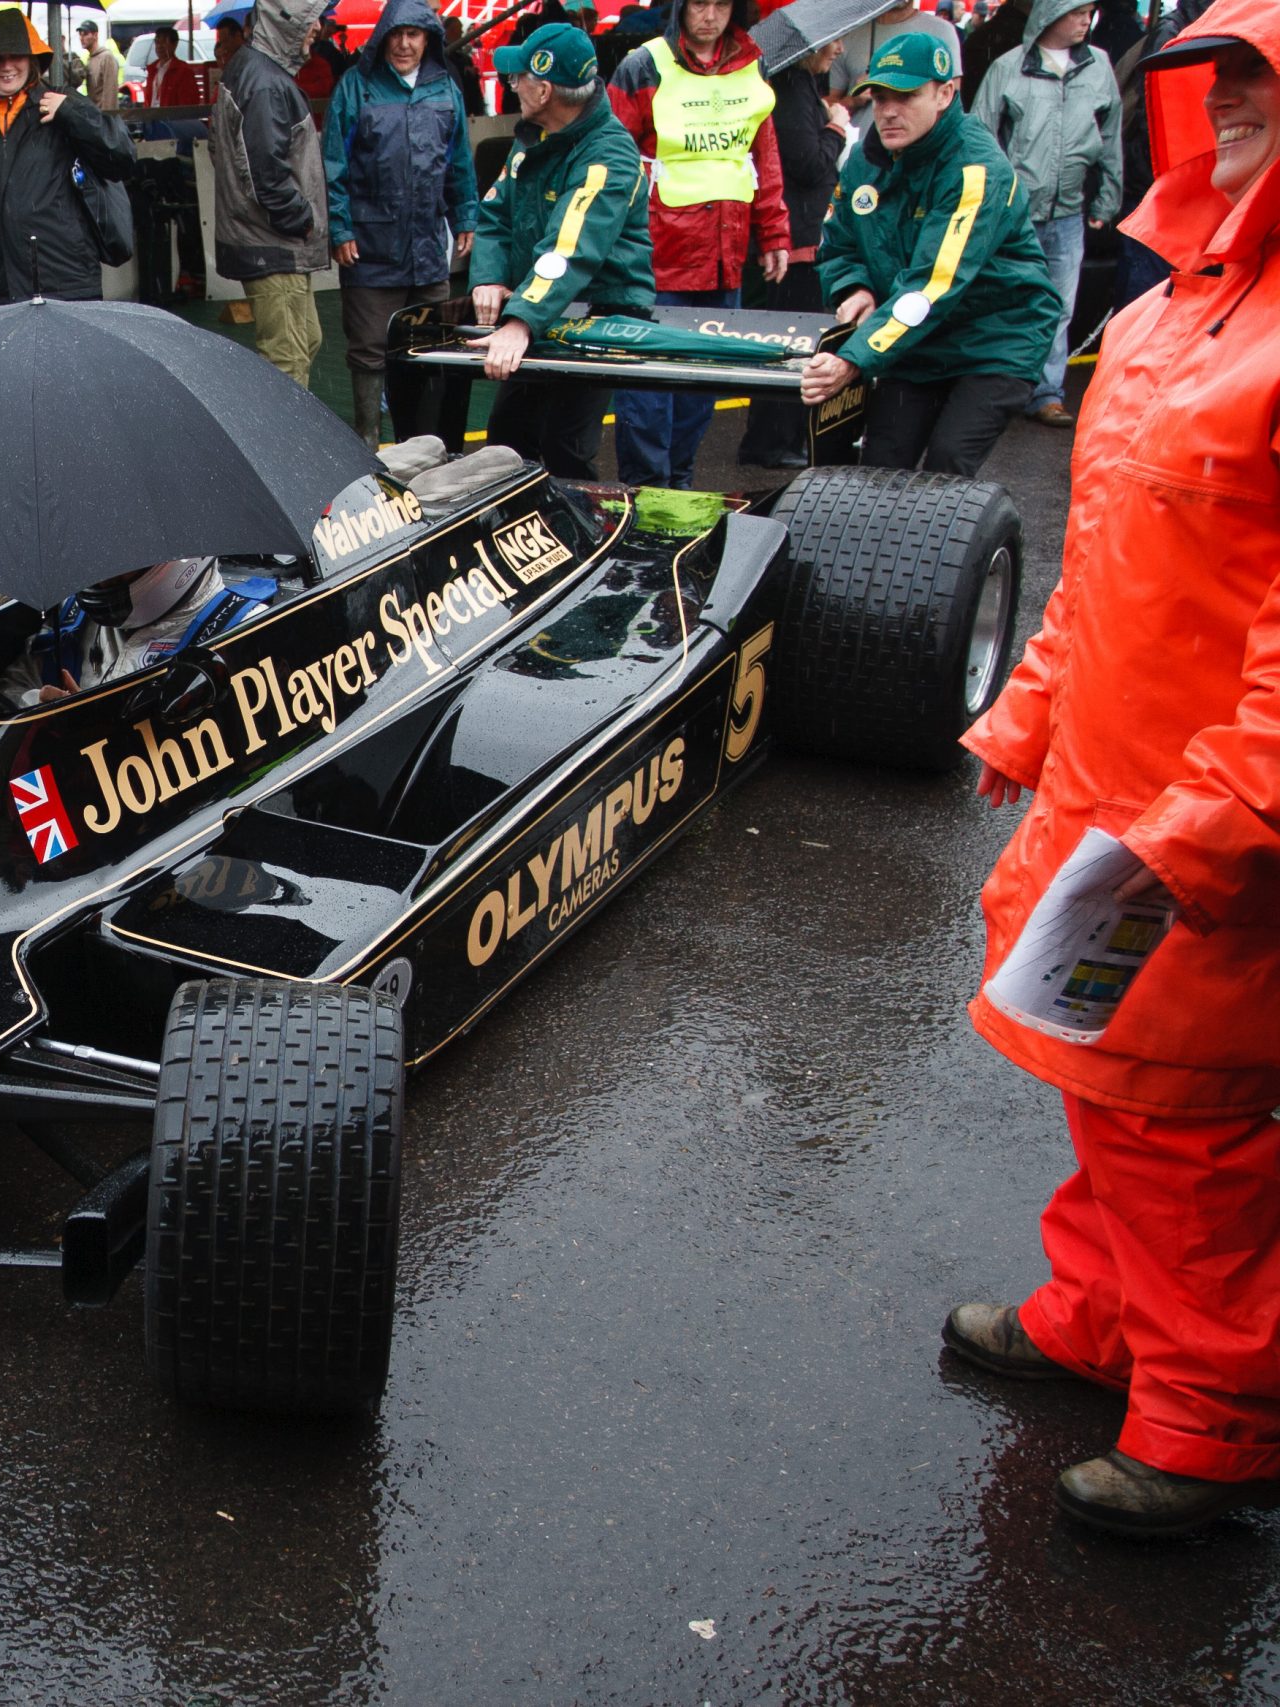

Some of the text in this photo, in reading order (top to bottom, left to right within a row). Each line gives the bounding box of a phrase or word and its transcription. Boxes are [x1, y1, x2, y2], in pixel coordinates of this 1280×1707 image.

[314, 490, 422, 560] Valvoline
[498, 518, 557, 569] NGK
[523, 549, 568, 580] SPARK PLUGS
[81, 541, 517, 833] John Player Special
[725, 621, 774, 762] 5
[467, 737, 685, 966] OLYMPUS
[548, 849, 620, 931] CAMERAS
